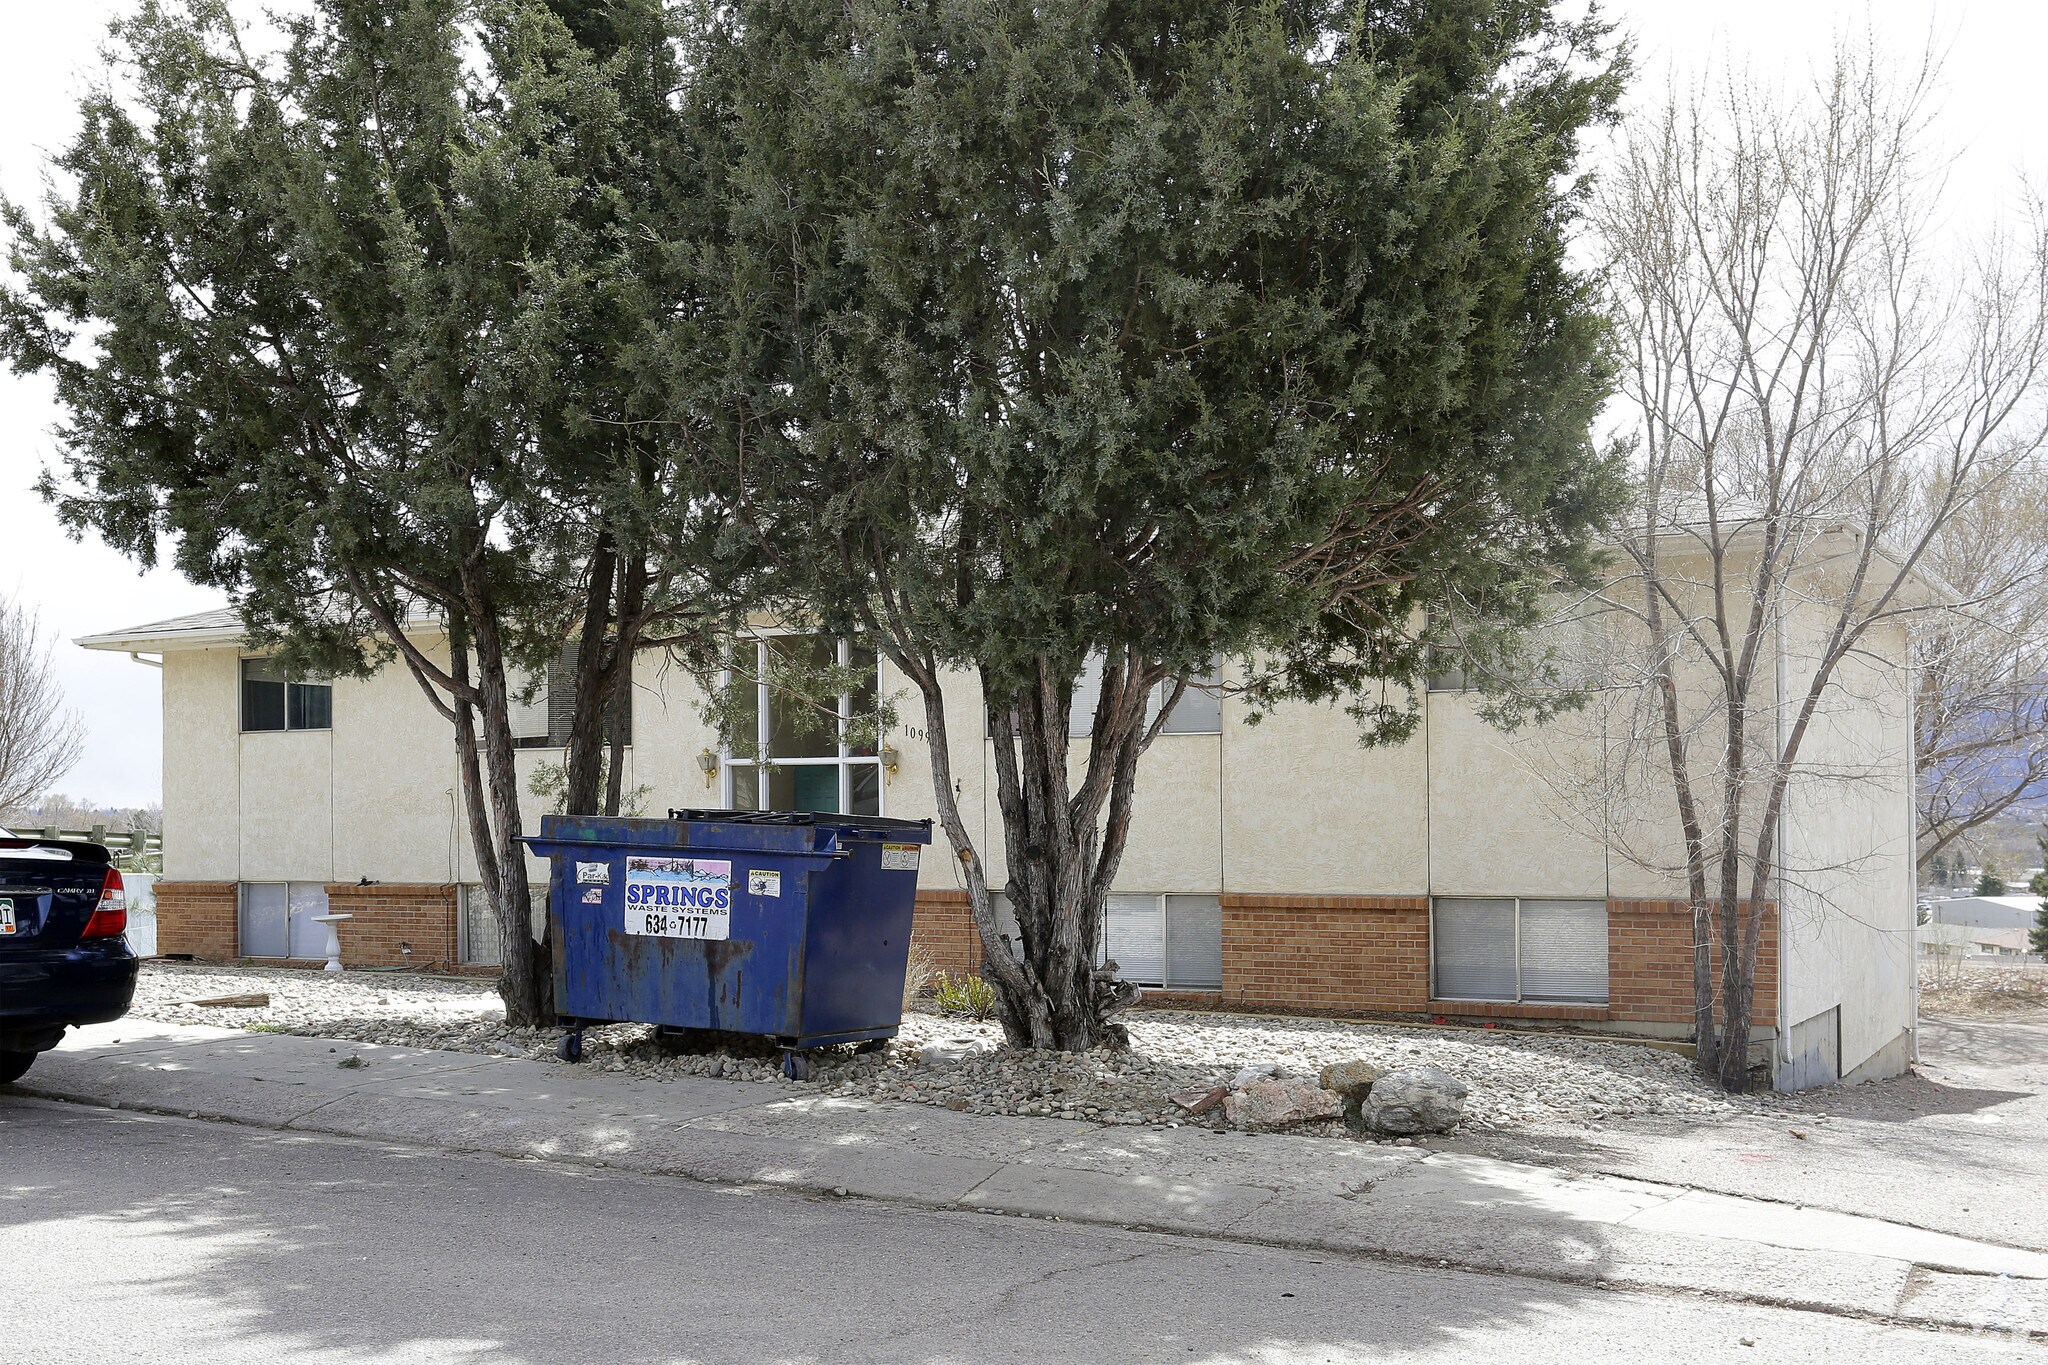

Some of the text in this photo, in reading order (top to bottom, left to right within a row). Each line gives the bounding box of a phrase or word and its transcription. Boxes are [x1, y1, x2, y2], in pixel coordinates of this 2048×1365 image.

[627, 884, 729, 909] SPRINGS
[627, 904, 728, 916] WASTE SYSTEMS
[645, 914, 708, 937] 634 7177
